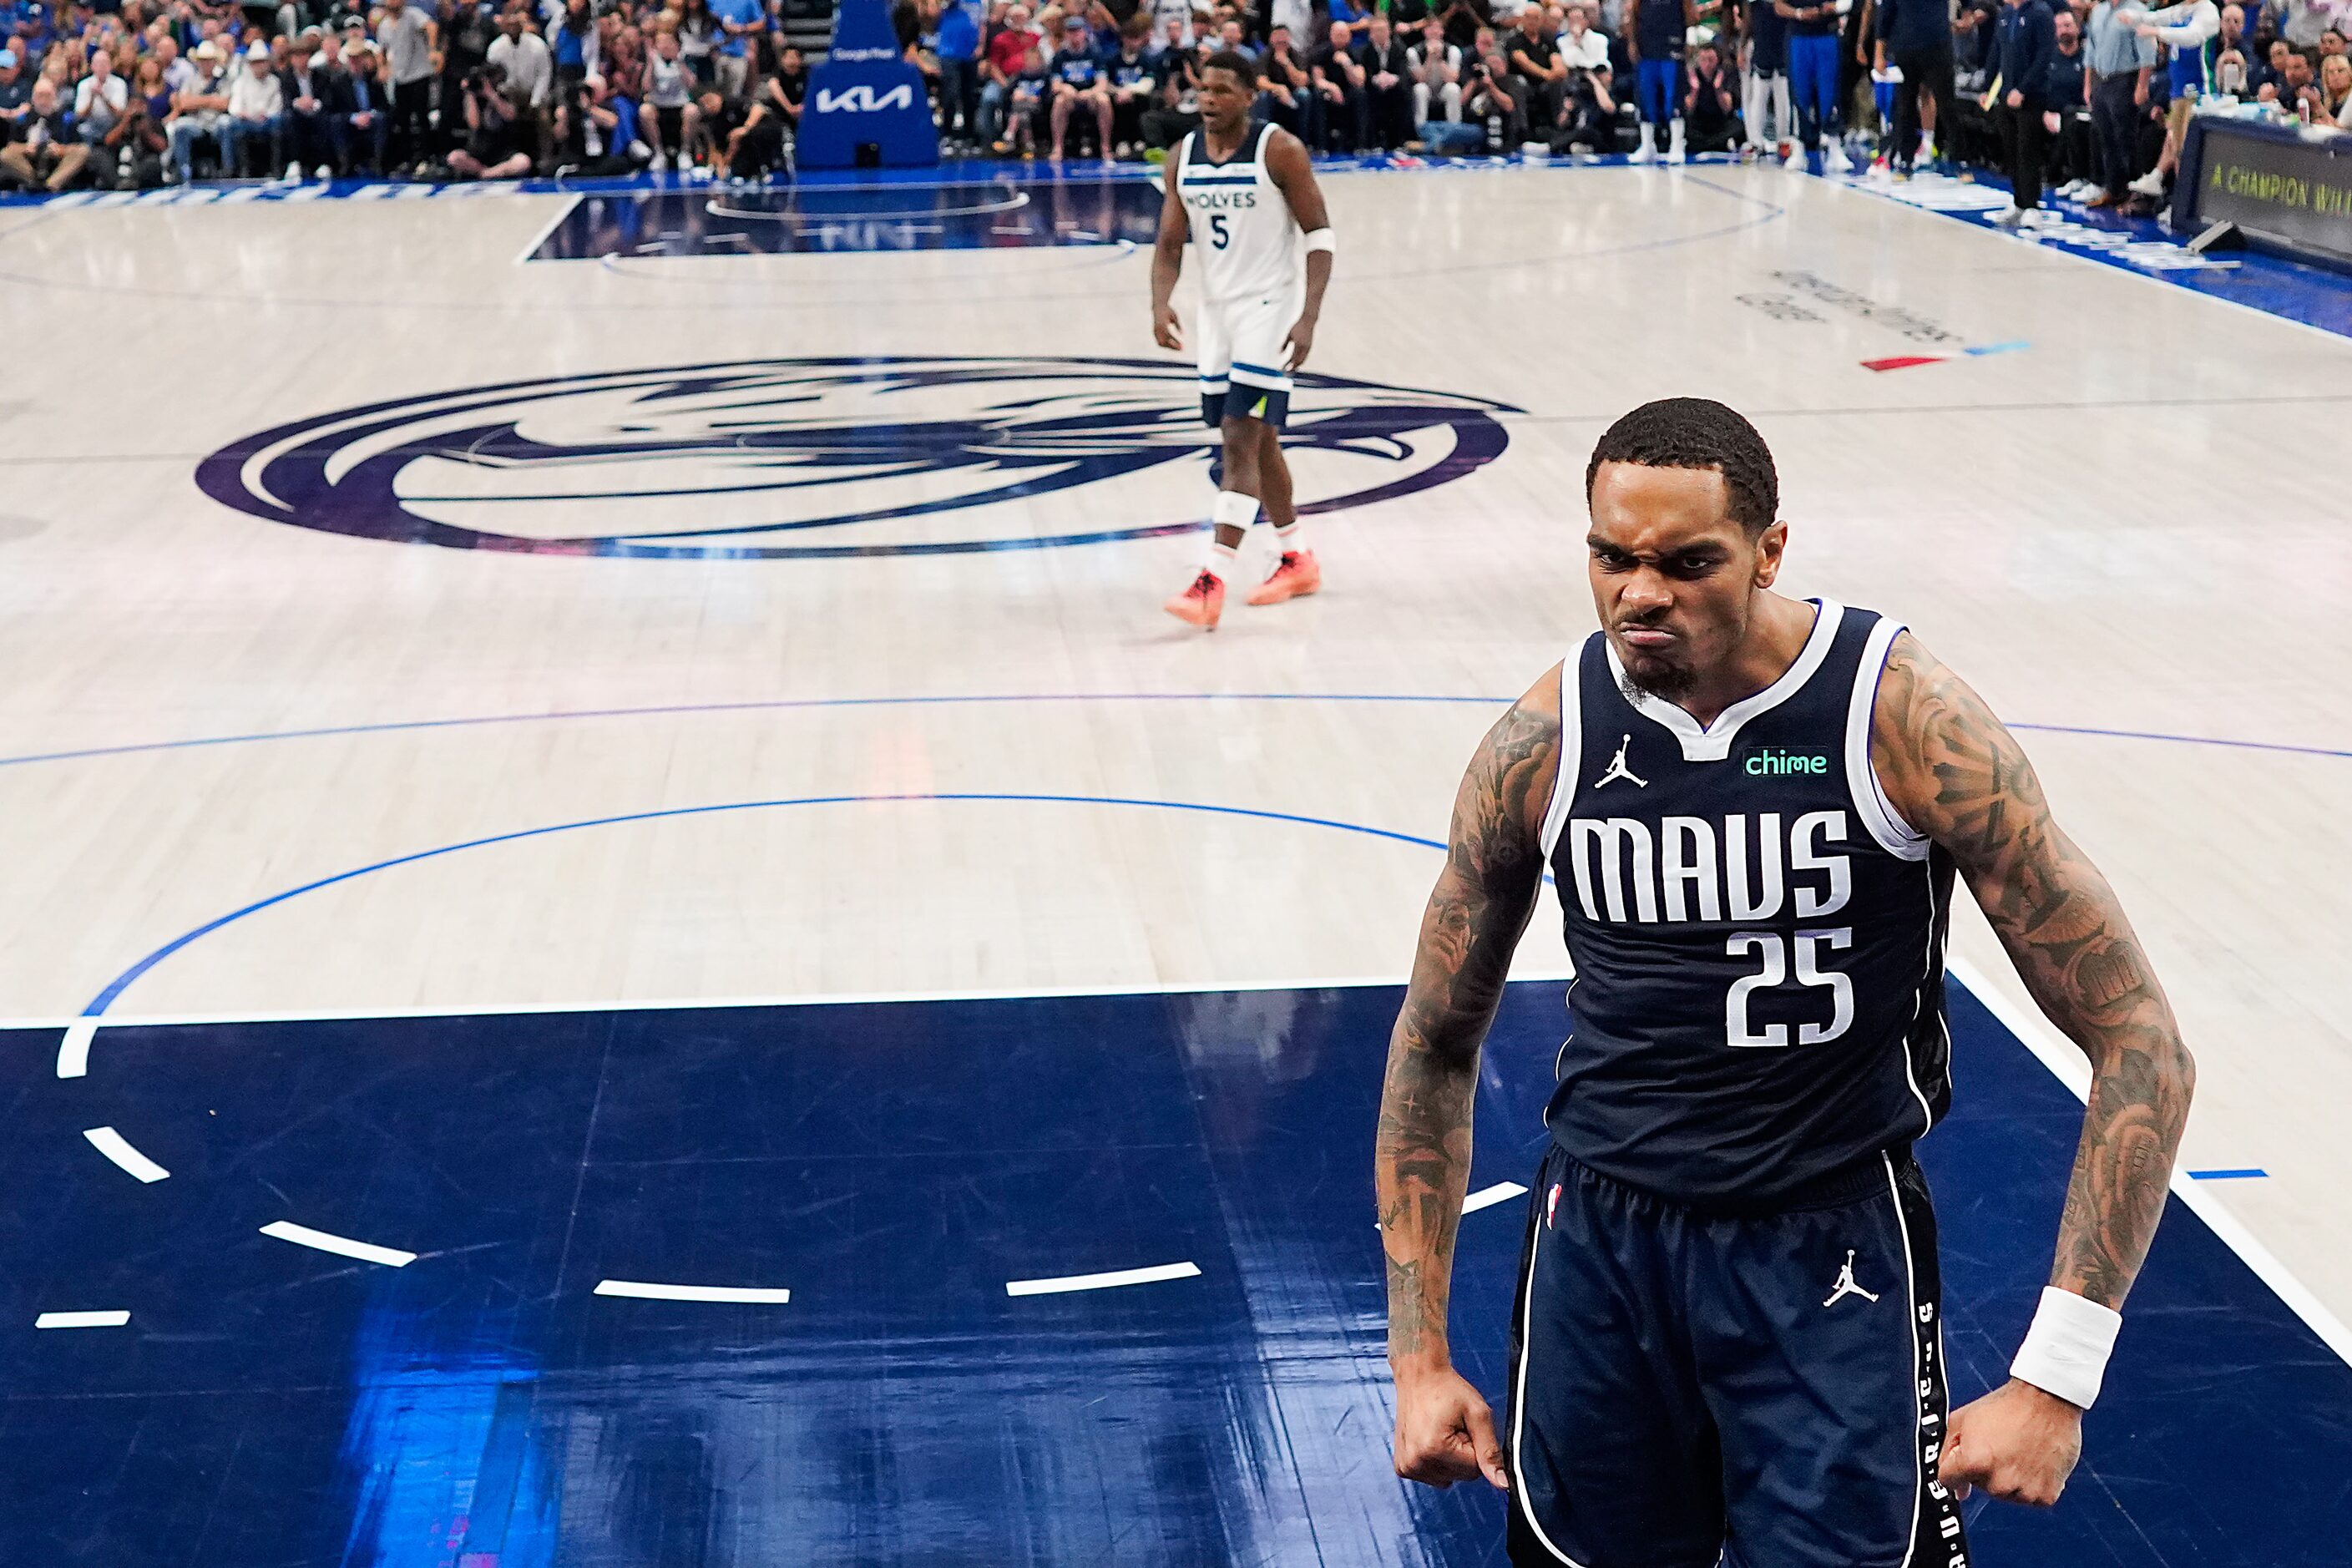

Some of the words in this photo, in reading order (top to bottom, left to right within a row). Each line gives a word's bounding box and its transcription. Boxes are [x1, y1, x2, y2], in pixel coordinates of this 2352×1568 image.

[816, 84, 913, 114] KIA
[1186, 192, 1257, 209] WOLVES
[2227, 165, 2309, 207] CHAMPION
[1211, 215, 1230, 250] 5
[1745, 749, 1828, 776] chime
[1570, 810, 1852, 923] MAVS
[1726, 926, 1854, 1048] 25
